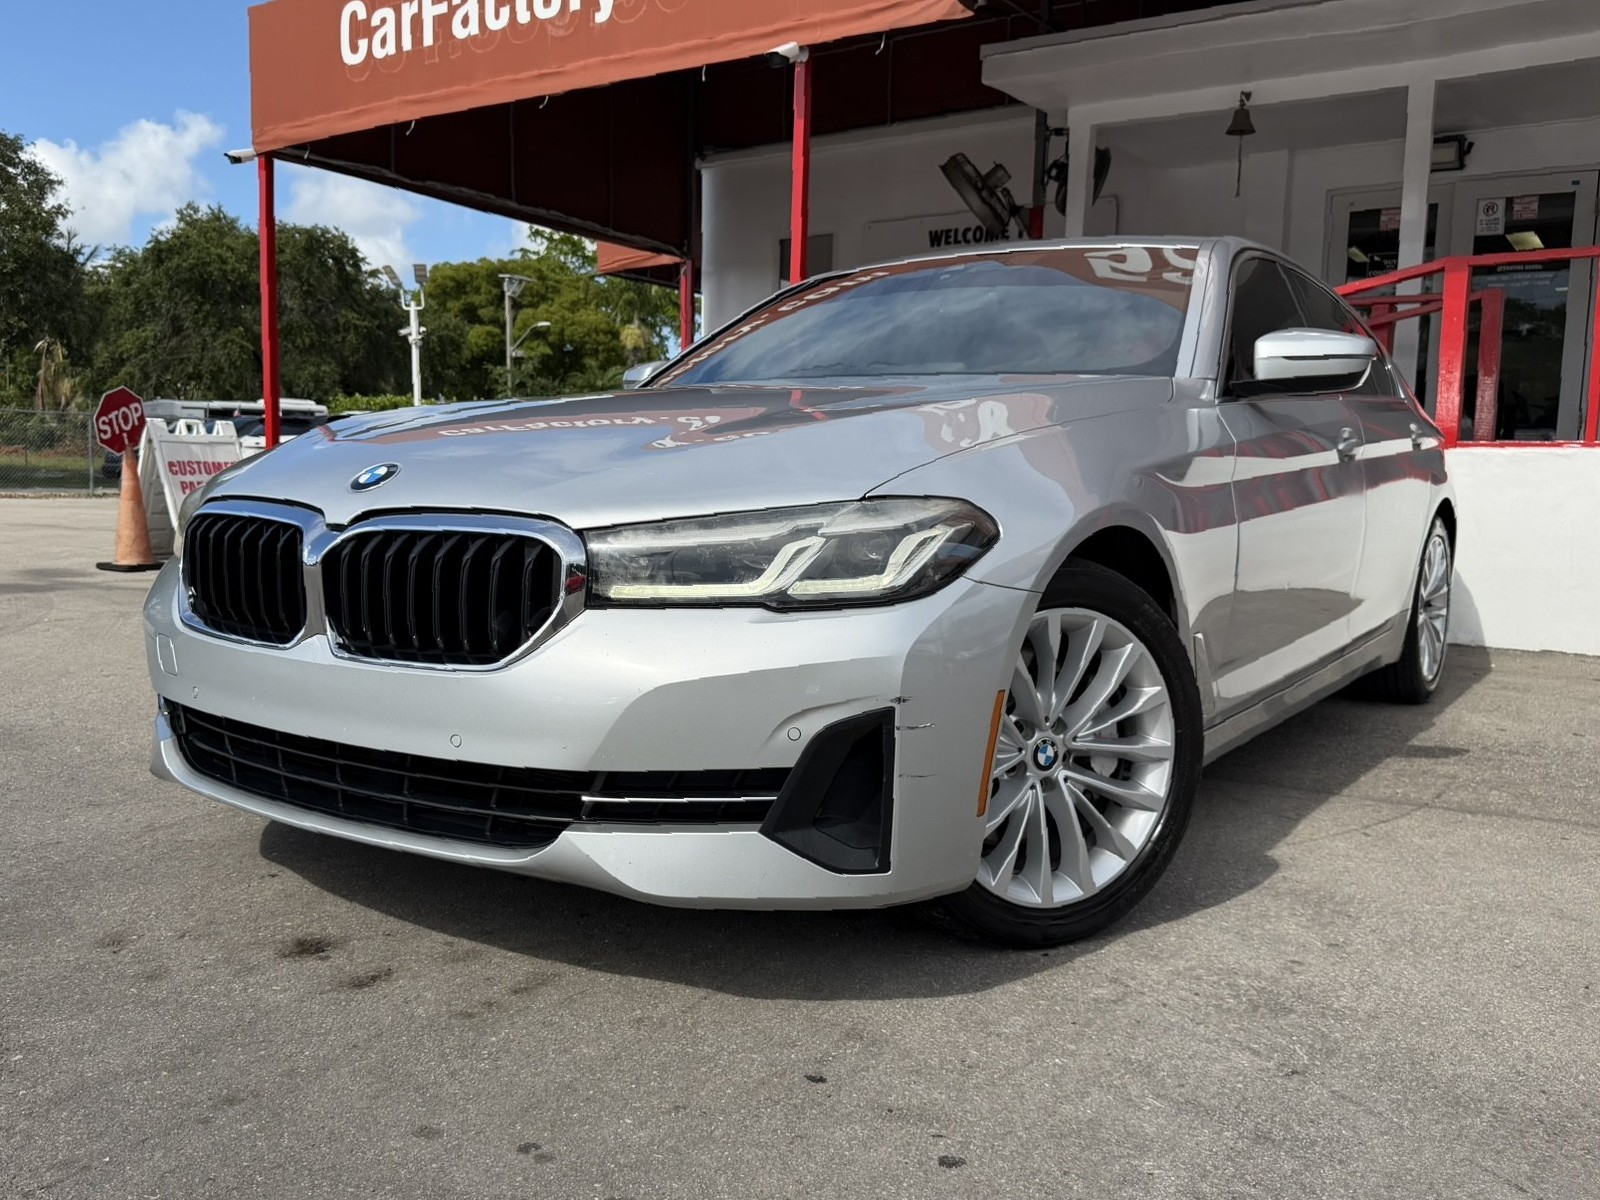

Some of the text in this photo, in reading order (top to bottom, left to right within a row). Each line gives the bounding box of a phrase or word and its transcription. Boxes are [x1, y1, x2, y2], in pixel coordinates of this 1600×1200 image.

[340, 0, 614, 67] CarFac
[98, 403, 142, 440] STOP
[167, 460, 236, 476] CUSTOM
[180, 481, 203, 495] PA
